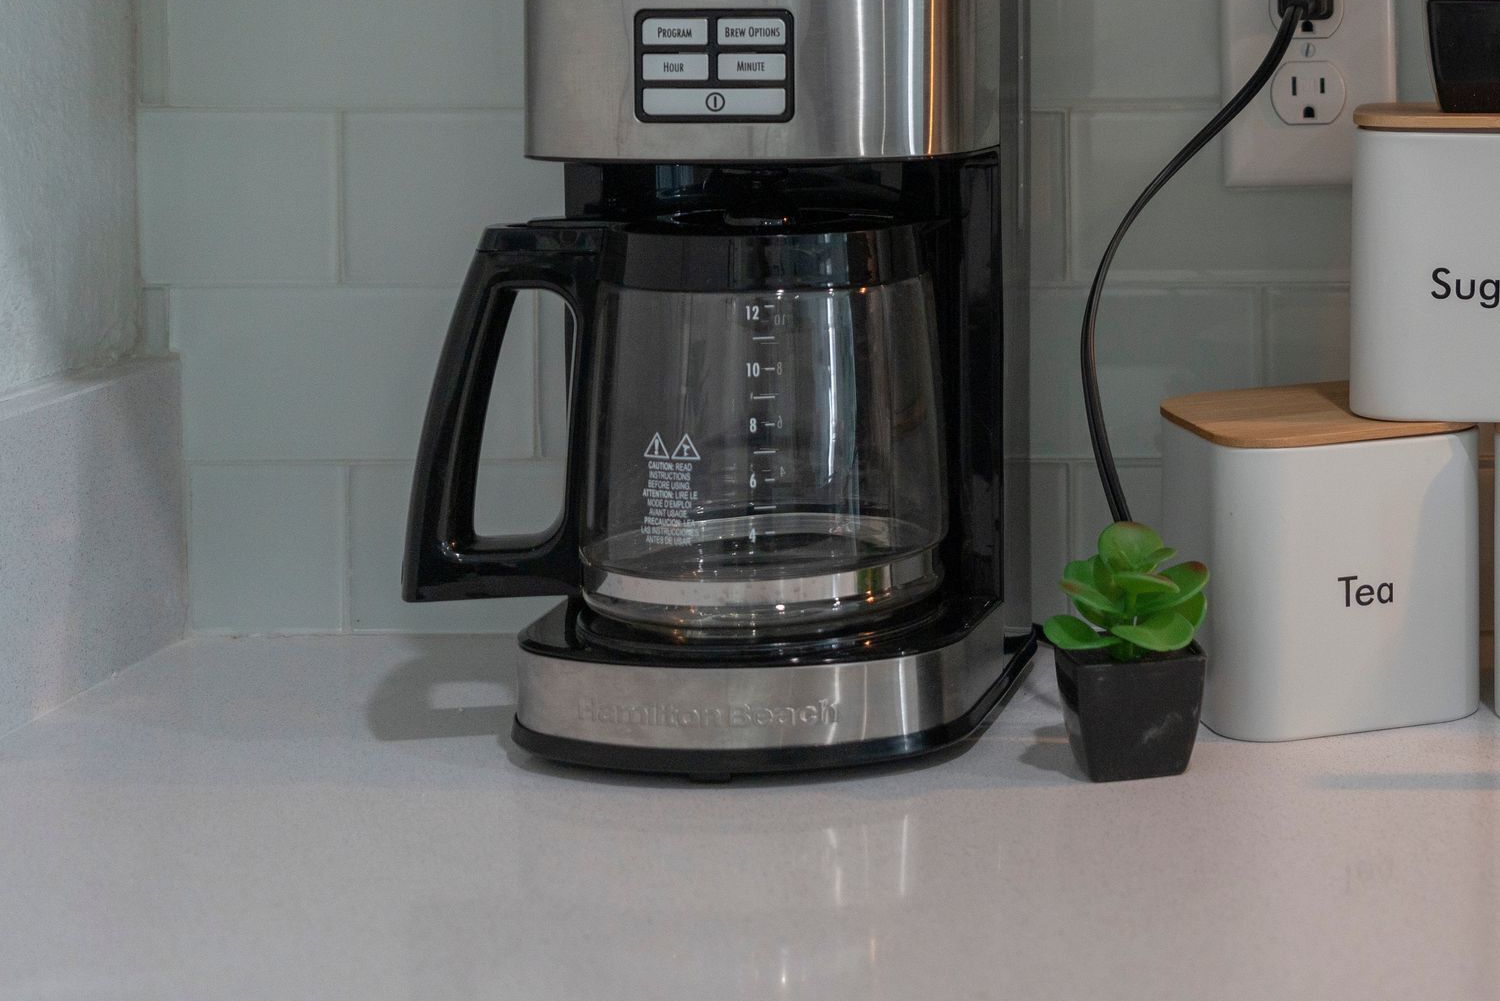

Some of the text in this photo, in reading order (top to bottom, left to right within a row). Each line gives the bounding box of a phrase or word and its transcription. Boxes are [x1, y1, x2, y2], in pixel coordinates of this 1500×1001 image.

[657, 26, 693, 38] PROGRAM
[725, 26, 781, 38] BREW OPTIONS
[663, 61, 684, 73] HOUR
[736, 61, 766, 72] MINUTE
[745, 305, 760, 321] 12
[746, 362, 760, 378] 10
[749, 417, 757, 433] 8
[675, 462, 693, 472] READ
[749, 472, 757, 488] 6
[690, 491, 699, 501] LE
[748, 528, 756, 543] 4
[1337, 575, 1394, 608] Tea
[729, 697, 840, 728] Beach
